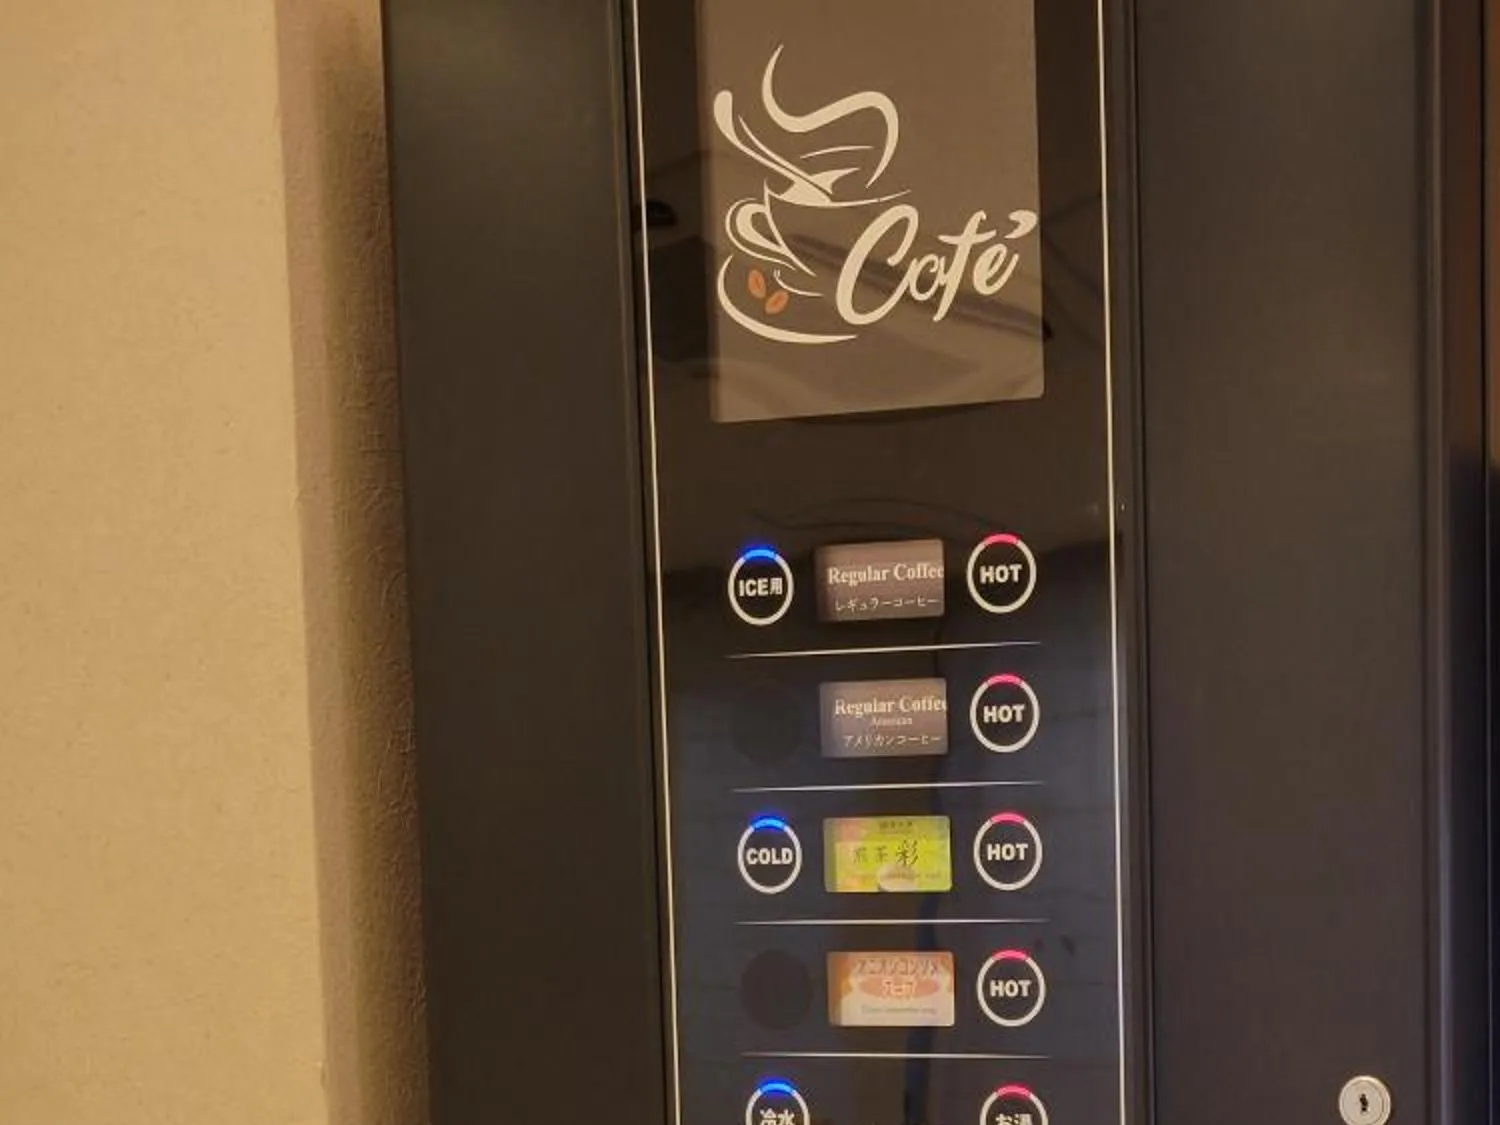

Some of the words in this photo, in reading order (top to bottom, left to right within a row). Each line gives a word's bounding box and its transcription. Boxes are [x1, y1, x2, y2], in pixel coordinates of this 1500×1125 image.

[827, 565, 890, 587] Regular
[980, 564, 1022, 584] HOT
[739, 577, 783, 598] ICE用
[834, 596, 940, 613] レギュラーコーヒー
[834, 698, 895, 718] Regular
[983, 703, 1025, 724] HOT
[842, 734, 942, 748] アメリカンコーヒー
[747, 847, 793, 866] COLD
[987, 842, 1028, 862] HOT
[990, 979, 1031, 999] HOT
